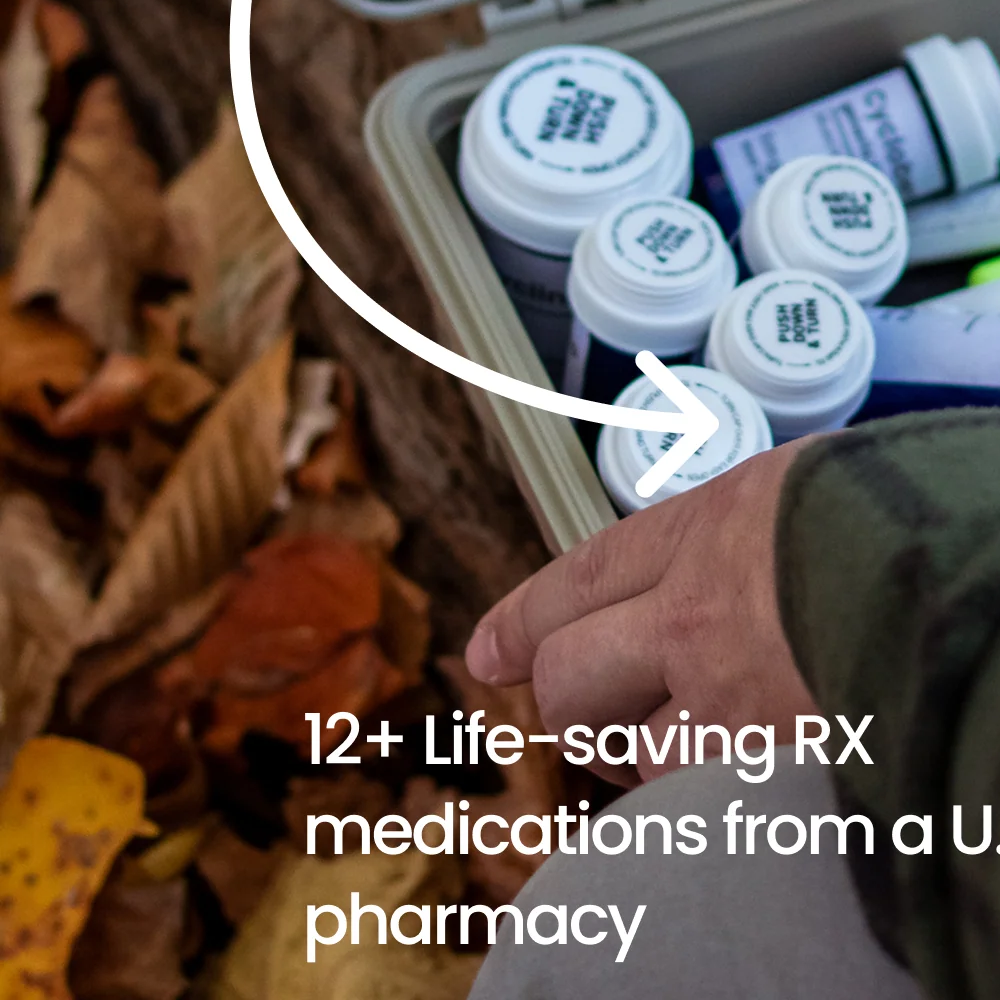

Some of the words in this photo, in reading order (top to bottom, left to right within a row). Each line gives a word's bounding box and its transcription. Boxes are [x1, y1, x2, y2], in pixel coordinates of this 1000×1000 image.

[776, 304, 791, 343] PUSH
[792, 303, 806, 343] DOWN
[804, 298, 820, 334] TURN
